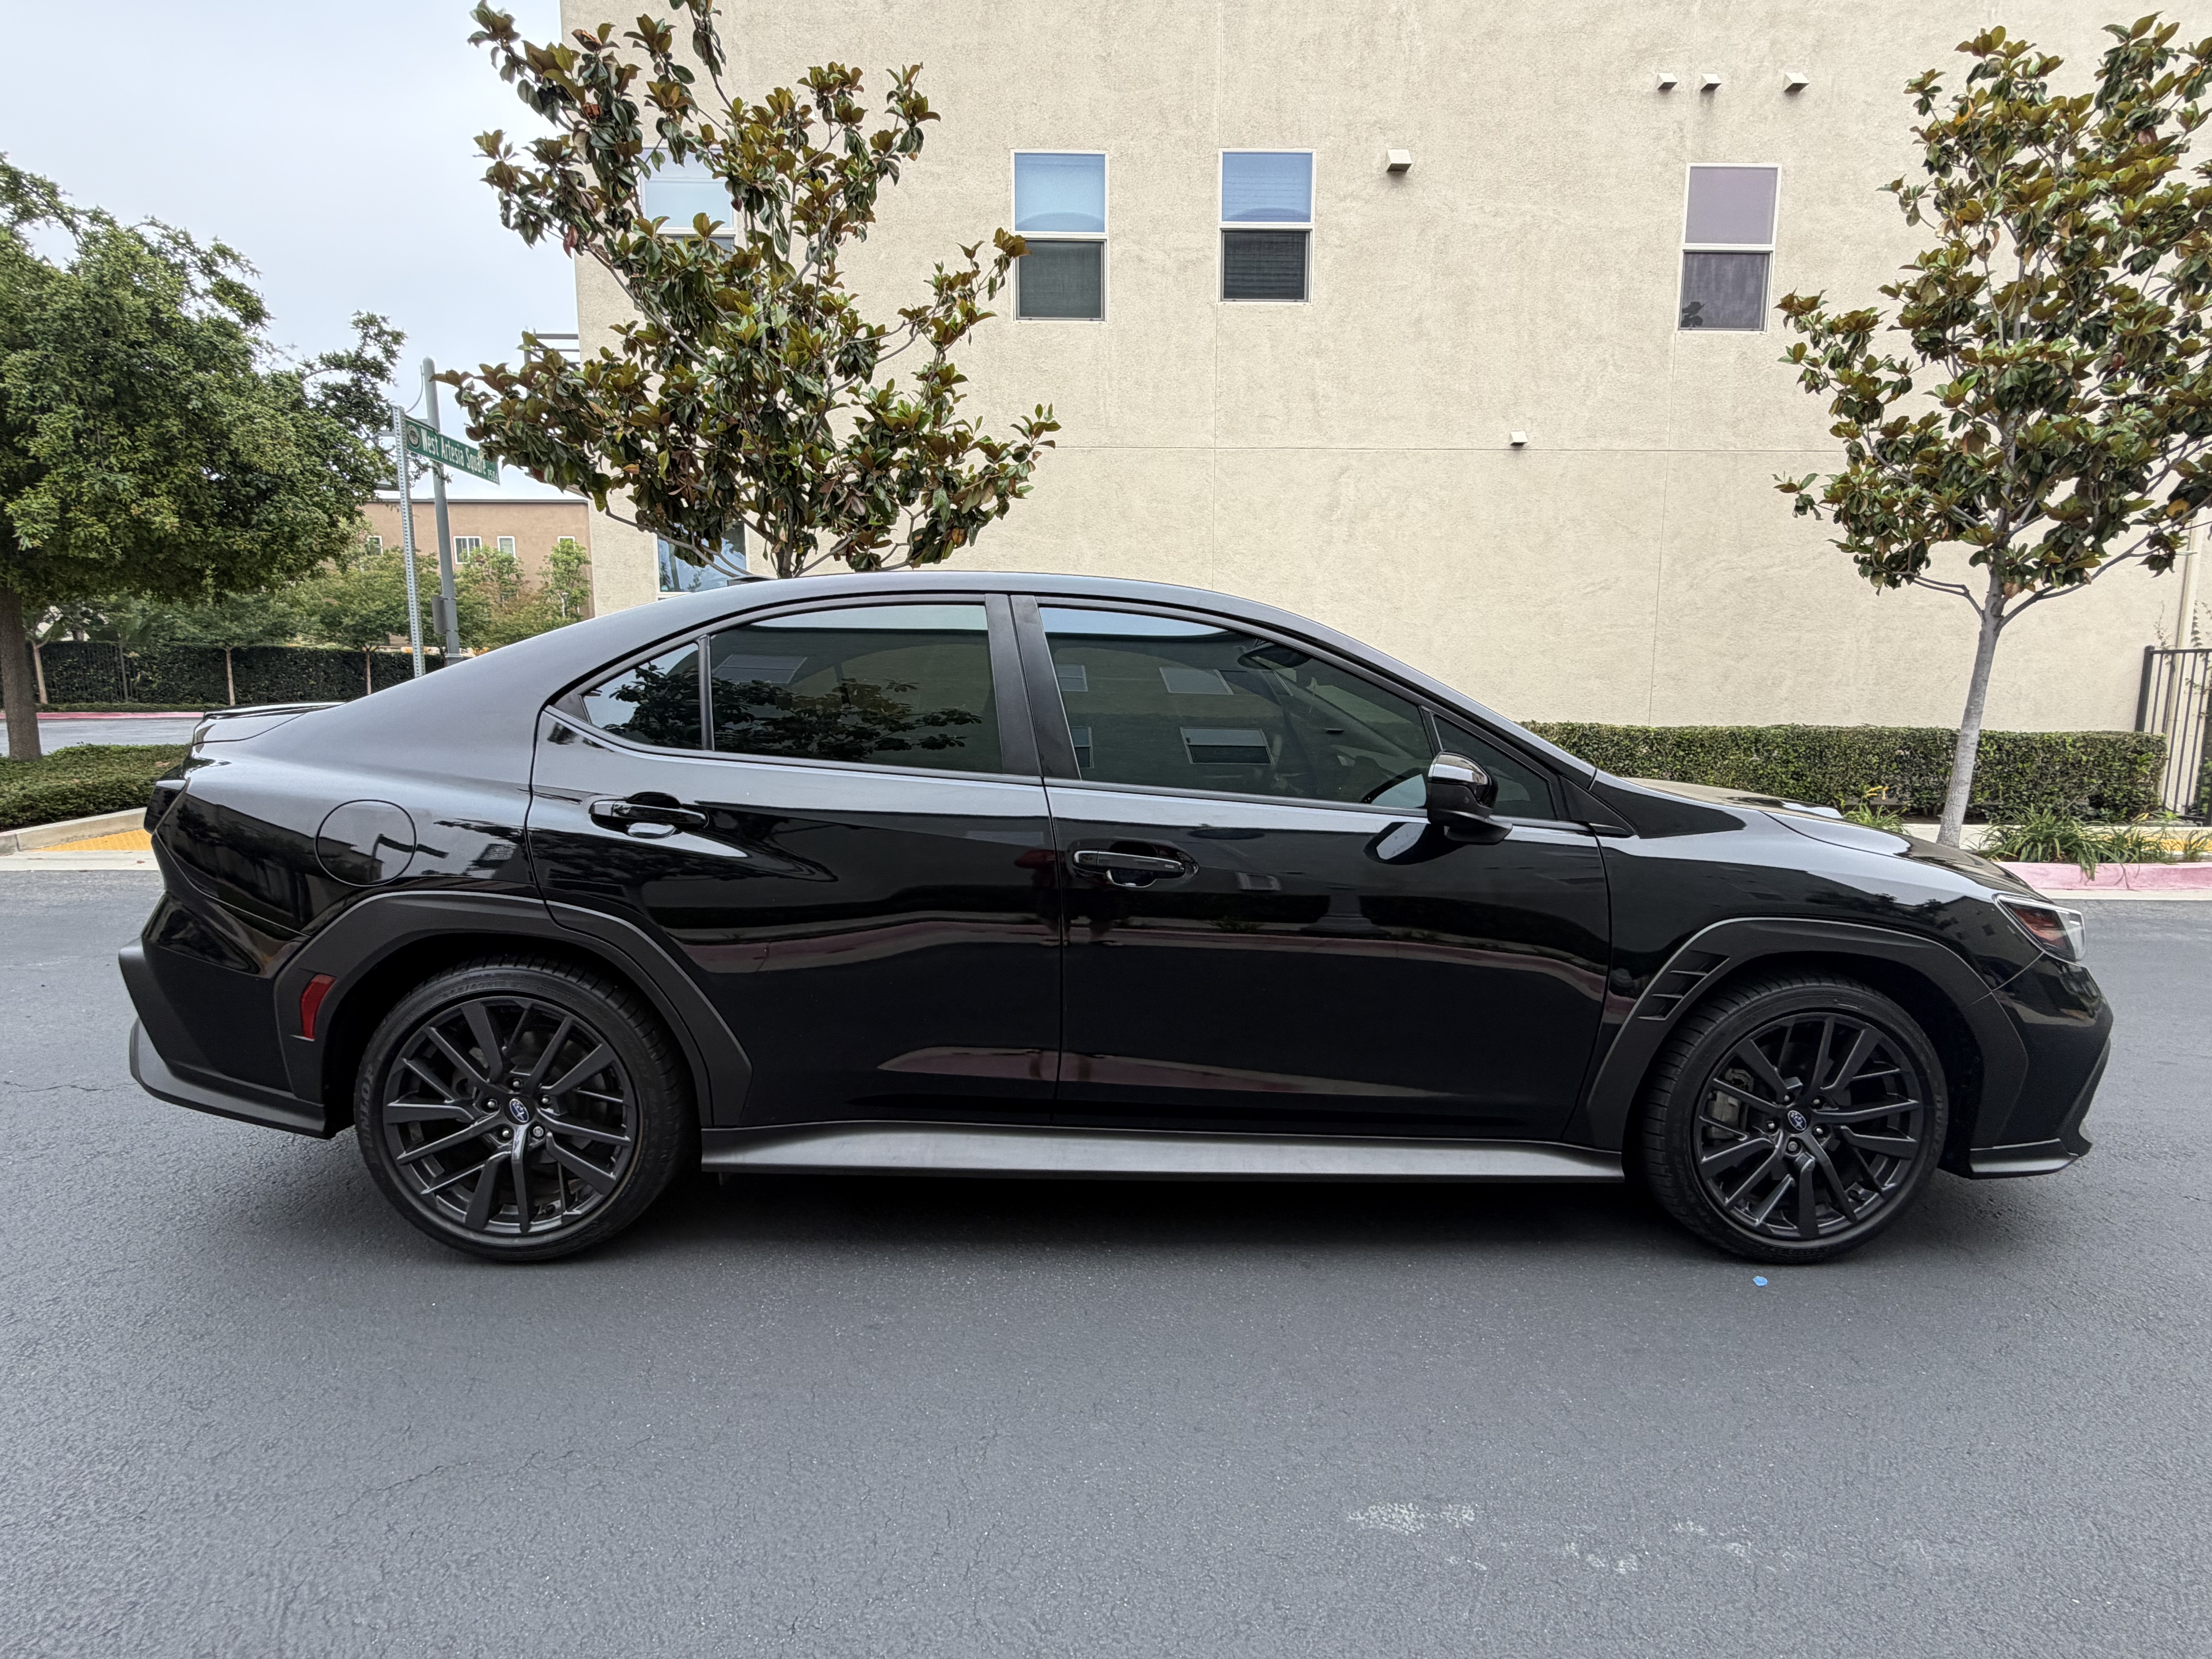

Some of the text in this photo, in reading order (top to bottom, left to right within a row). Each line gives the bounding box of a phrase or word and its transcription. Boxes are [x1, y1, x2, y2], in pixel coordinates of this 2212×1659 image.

[421, 429, 439, 456] West
[441, 437, 464, 466] Artesia
[465, 447, 486, 474] Square
